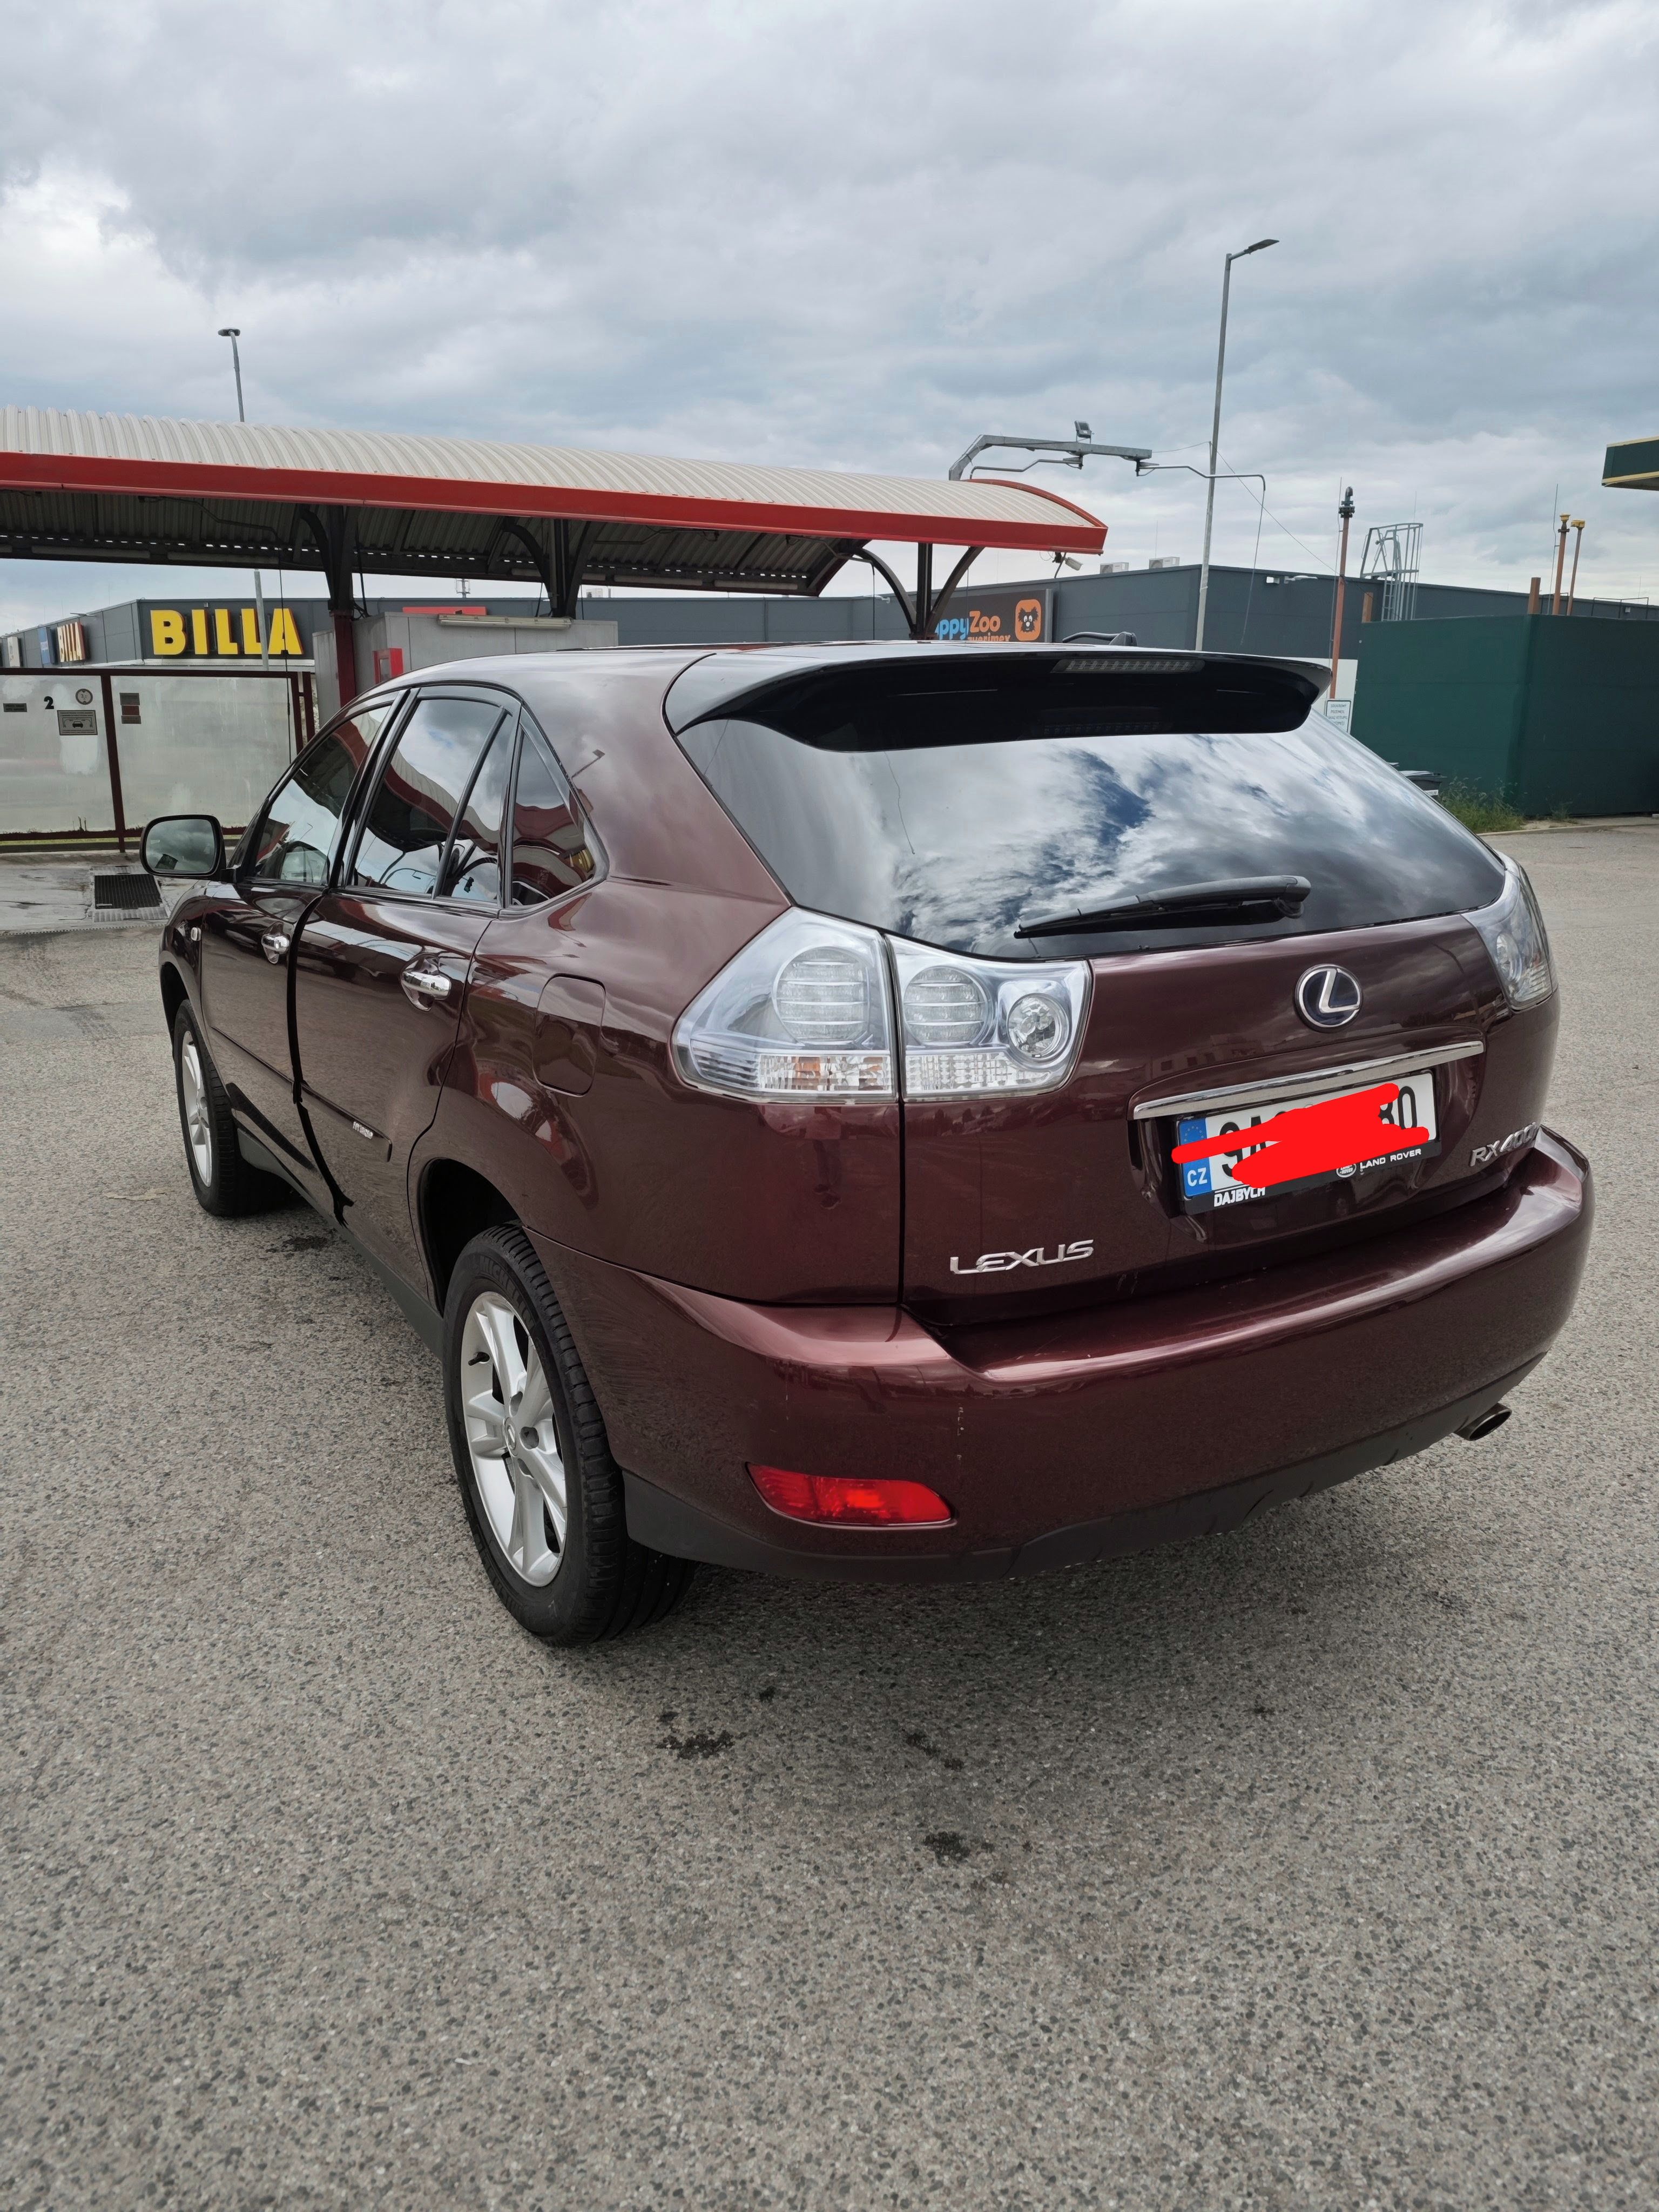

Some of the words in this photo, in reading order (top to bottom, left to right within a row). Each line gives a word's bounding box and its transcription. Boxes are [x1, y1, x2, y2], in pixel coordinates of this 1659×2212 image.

[57, 622, 83, 663] BILLA
[150, 608, 304, 655] BILLA
[44, 696, 54, 709] 2
[1360, 1157, 1386, 1169] LAND
[1390, 1149, 1421, 1162] ROVER
[1187, 1167, 1208, 1187] CZ
[1213, 1186, 1266, 1208] DAJBYCH
[950, 1239, 1094, 1275] LEXUS
[479, 1254, 536, 1332] MICHELIN
